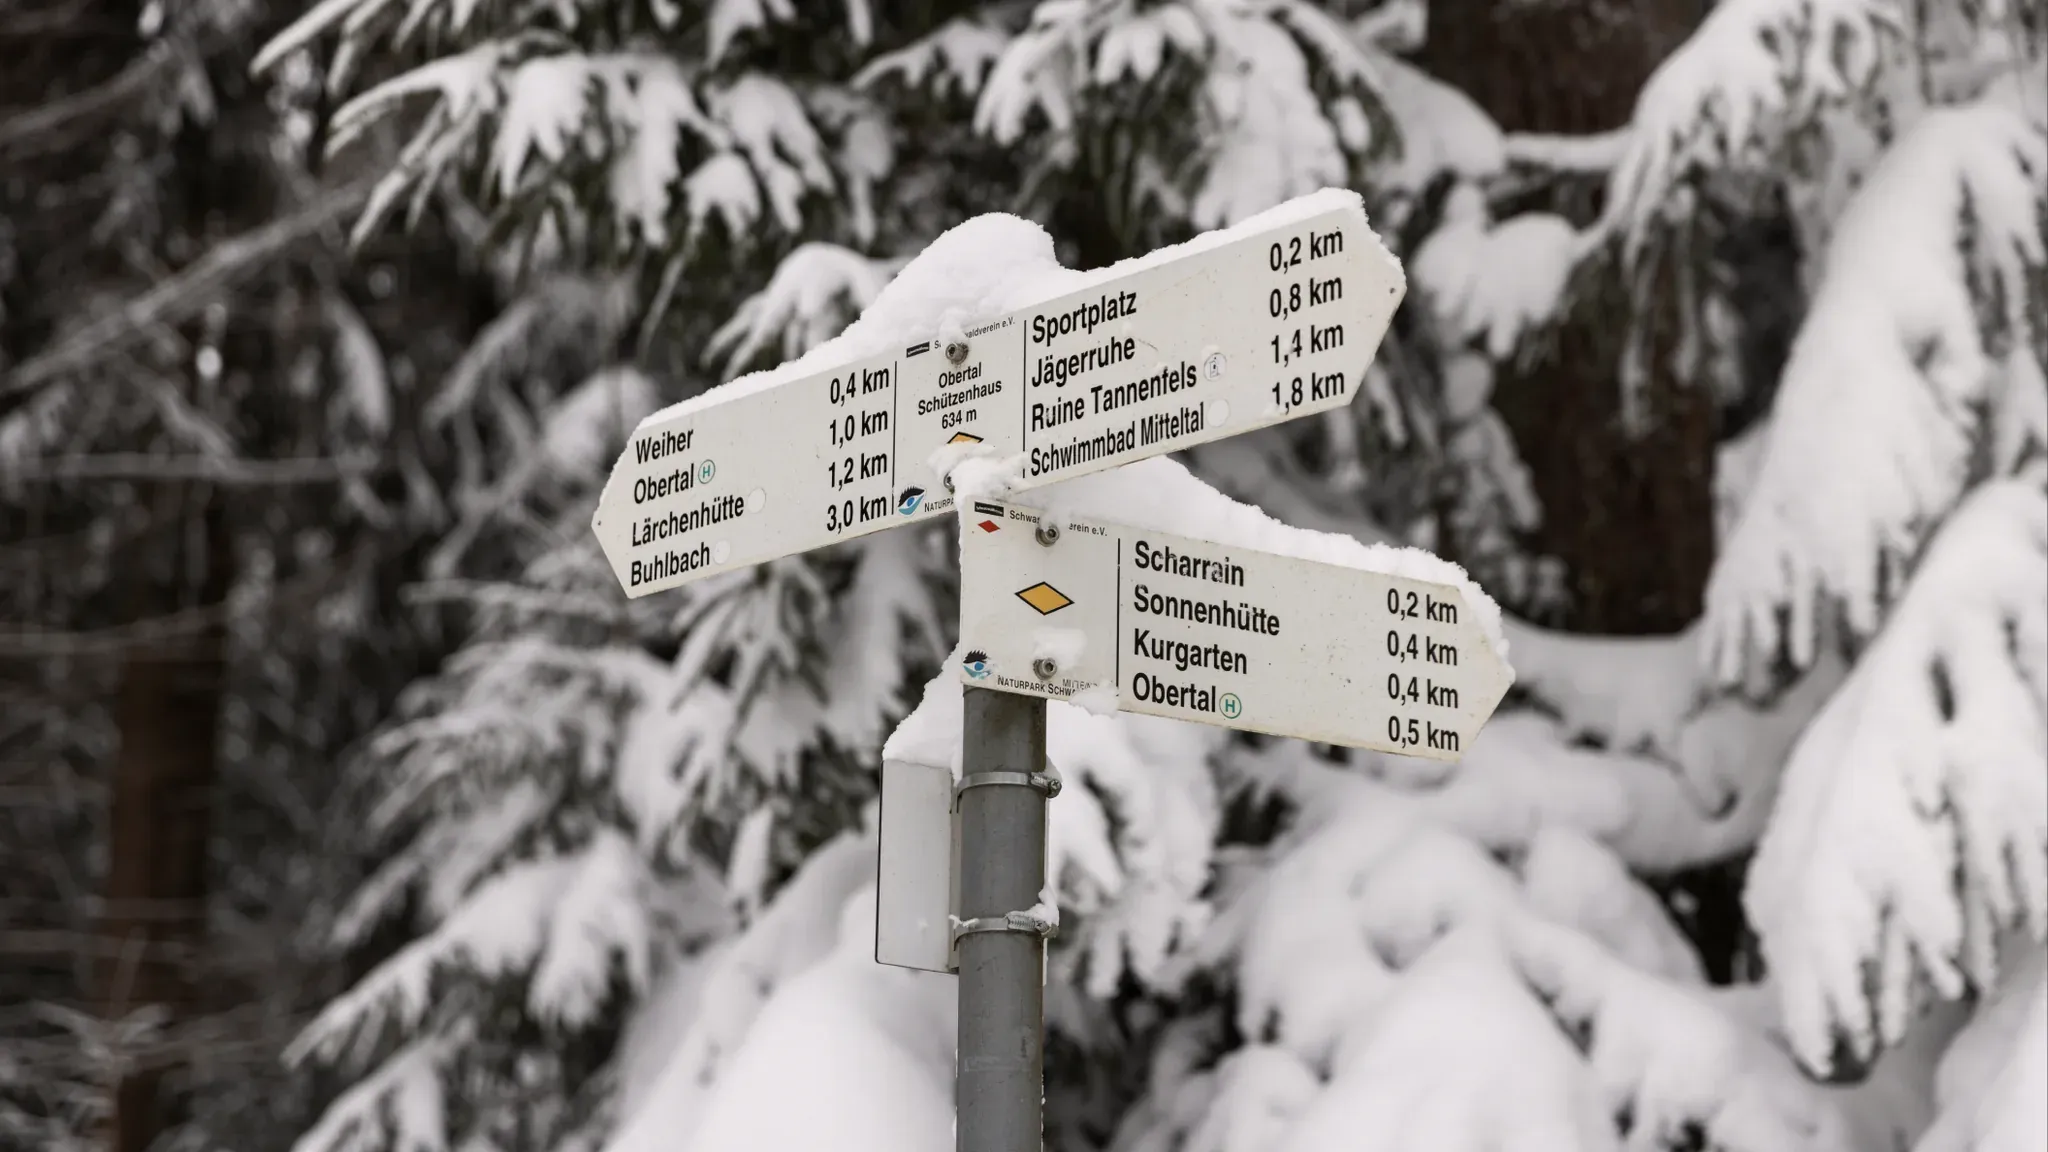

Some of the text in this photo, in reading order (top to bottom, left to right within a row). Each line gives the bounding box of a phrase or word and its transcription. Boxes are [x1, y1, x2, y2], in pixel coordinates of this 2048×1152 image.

[1031, 277, 1342, 388] Jägerruhe 0,8 km
[1032, 229, 1343, 347] Sportplatz 0,2 km
[636, 368, 890, 464] Weiher 0,4 km
[918, 380, 1002, 415] Schützenhaus
[938, 362, 982, 388] Obertal
[942, 408, 977, 429] 634 m
[1032, 324, 1344, 433] Ruine Tannenfels 1,4 km
[634, 463, 694, 504] Obertal
[829, 414, 855, 448] 1,0
[861, 409, 888, 436] km
[1031, 371, 1344, 476] Schwimmbad Mitteltal 1,8 km
[631, 495, 887, 586] Buhlbach 3,0 km
[632, 452, 887, 546] Lärchenhütte 1,2 km
[1134, 540, 1457, 624] Scharrain 0,2 km
[1134, 584, 1457, 666] Sonnenhütte 0,4 km
[1133, 672, 1216, 713] Obertal
[1388, 716, 1419, 749] 0,5
[1427, 722, 1459, 752] km
[1134, 628, 1458, 709] Kurgarten 0,4 km
